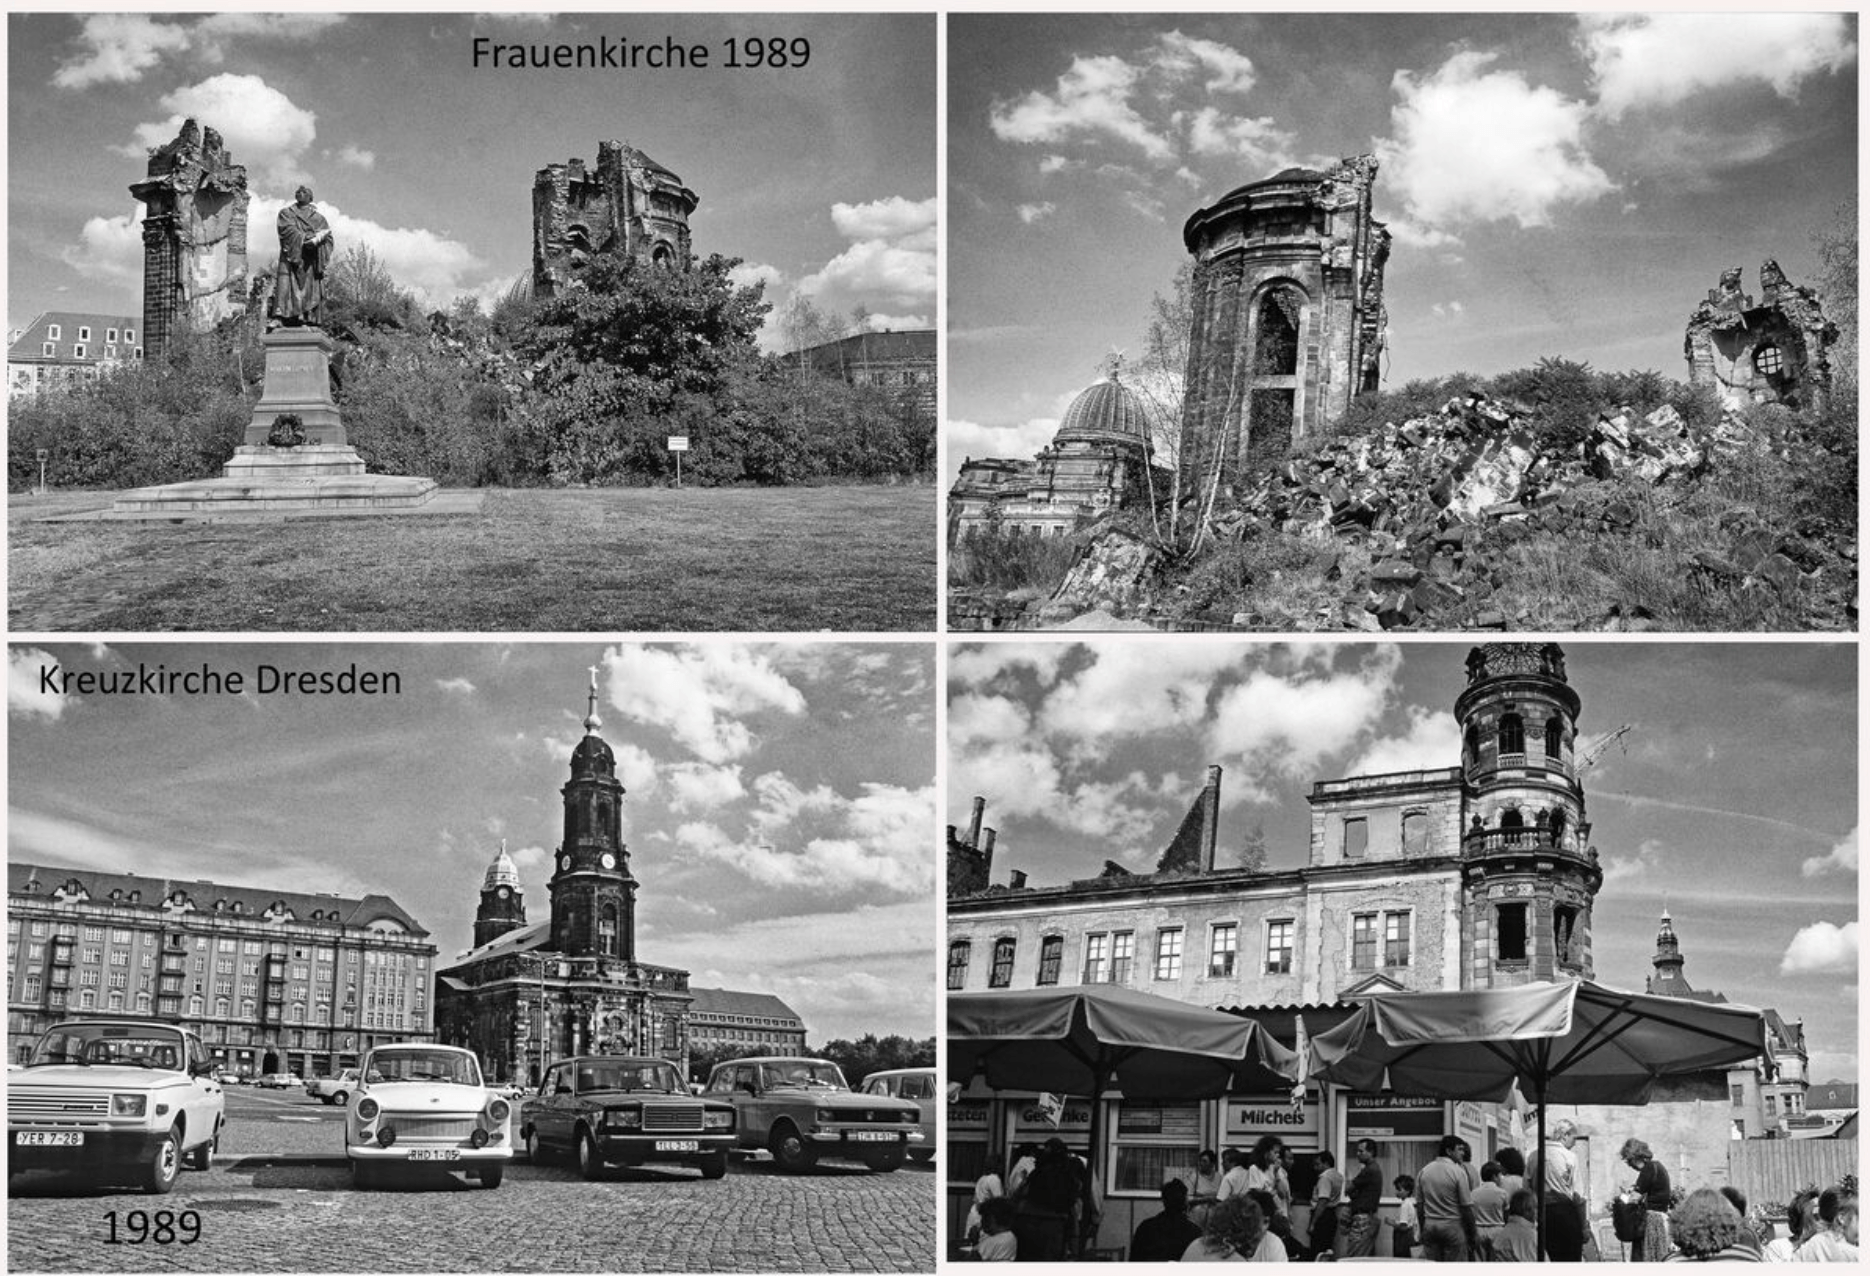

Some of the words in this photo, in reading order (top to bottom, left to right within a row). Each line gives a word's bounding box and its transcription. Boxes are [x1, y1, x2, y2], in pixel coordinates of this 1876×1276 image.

[1355, 1098, 1386, 1107] Unser
[1240, 1109, 1306, 1125] Milcheis
[21, 1132, 45, 1145] YER
[49, 1132, 79, 1145] 7-28
